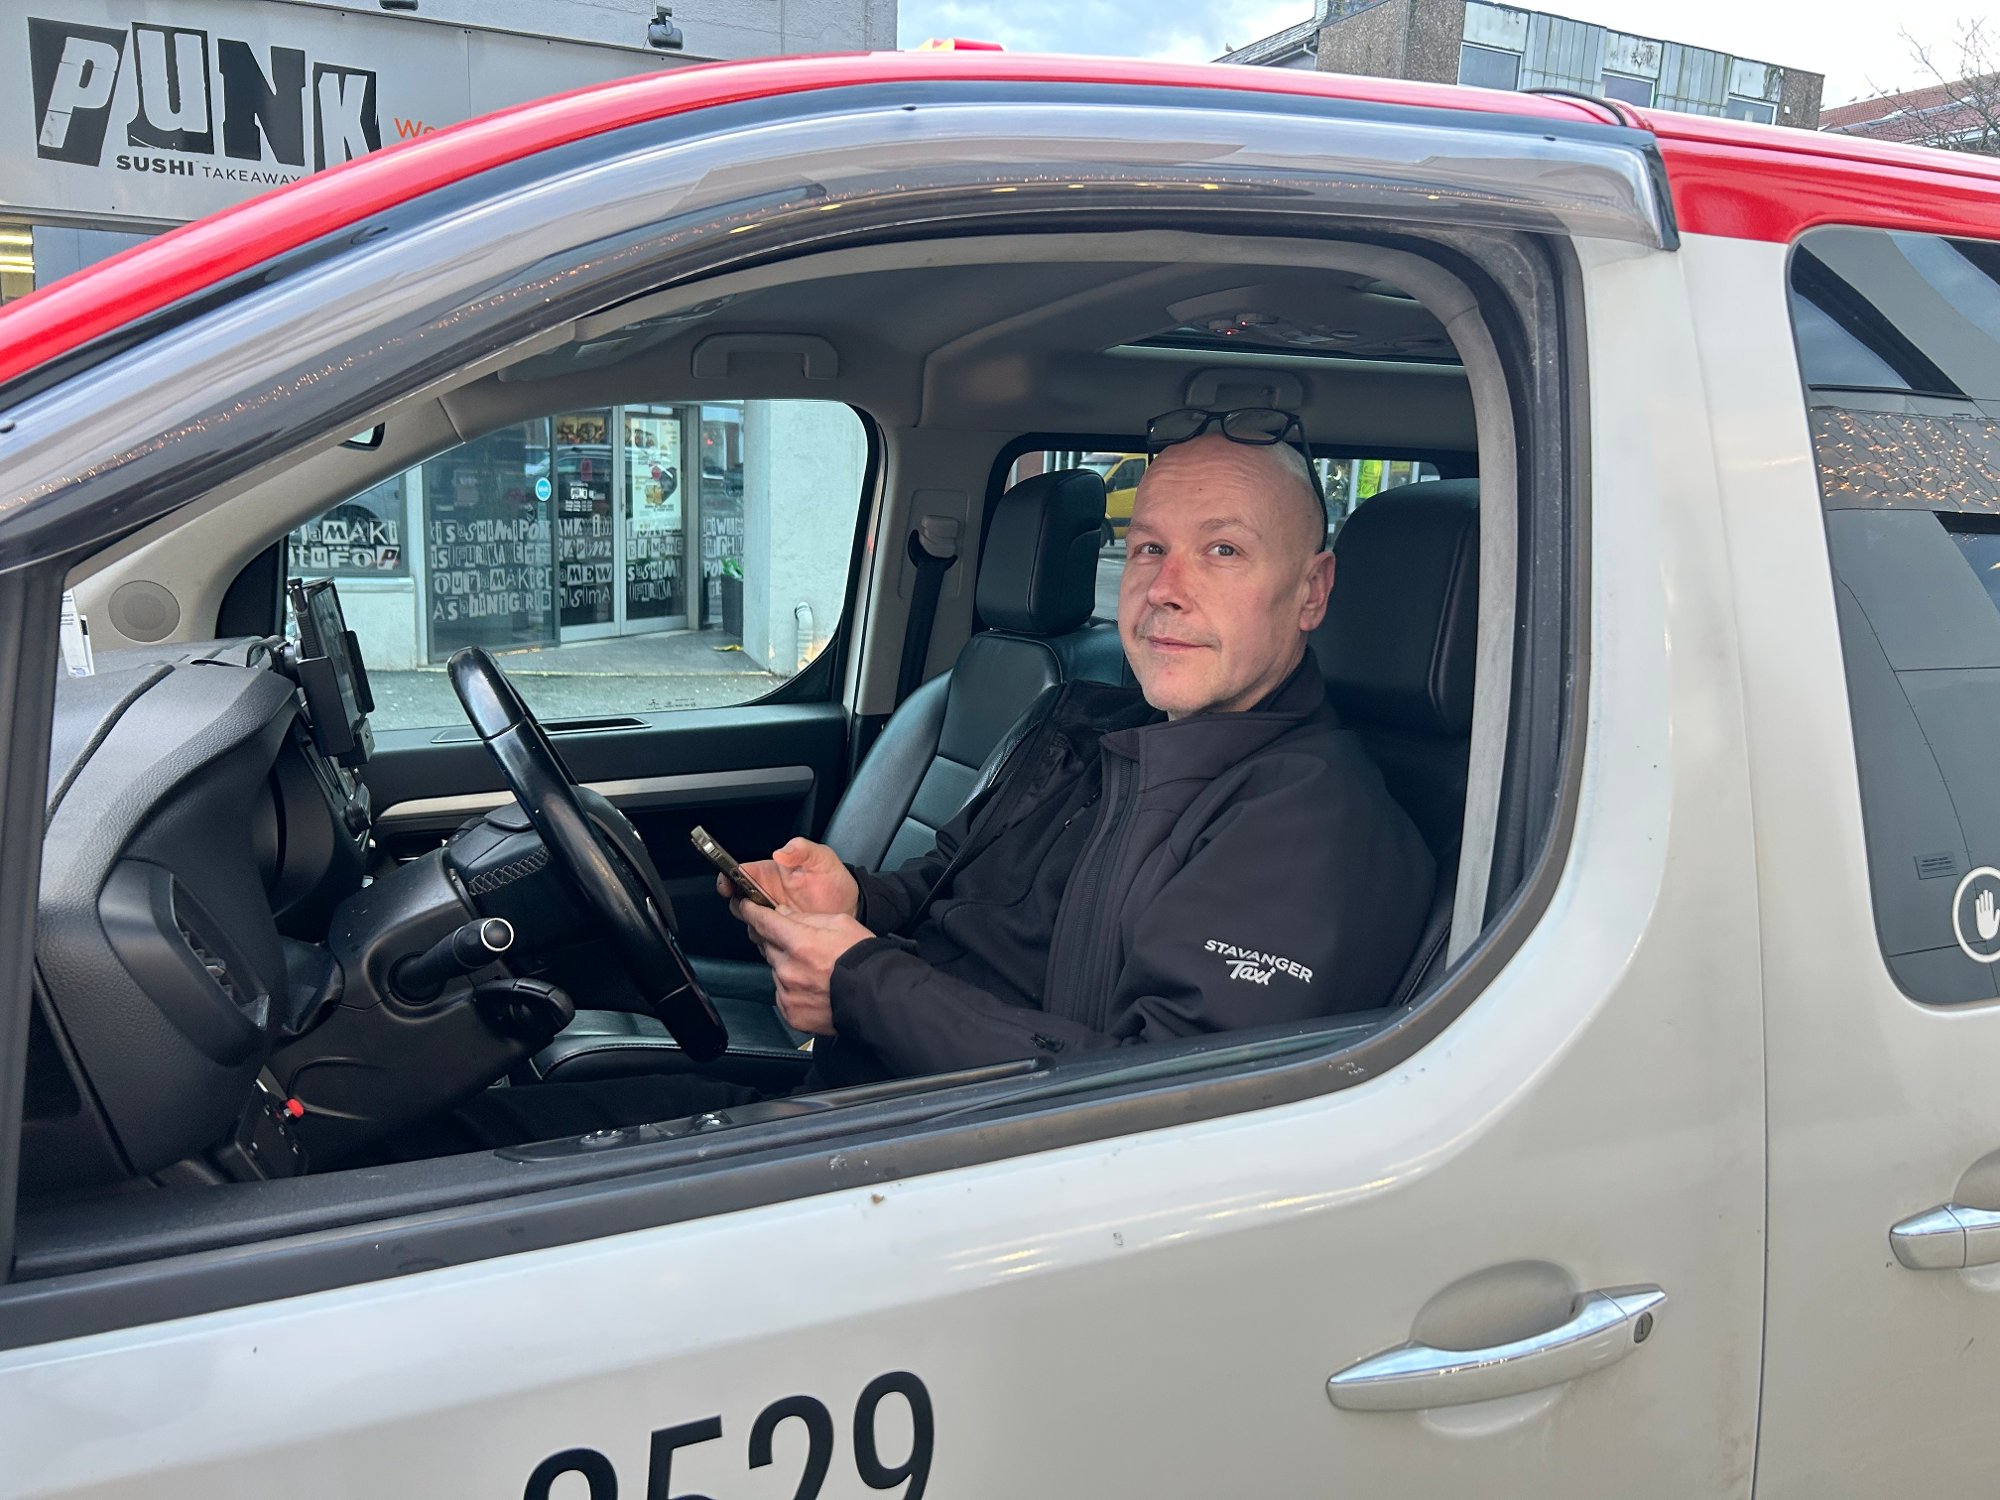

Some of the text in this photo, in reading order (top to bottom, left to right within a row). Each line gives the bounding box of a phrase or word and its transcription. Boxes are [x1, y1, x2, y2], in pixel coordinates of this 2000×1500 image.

[27, 17, 381, 173] PUNK
[116, 154, 195, 177] SUSHI
[1204, 939, 1313, 983] STAVANGER
[1225, 959, 1276, 985] Taxi
